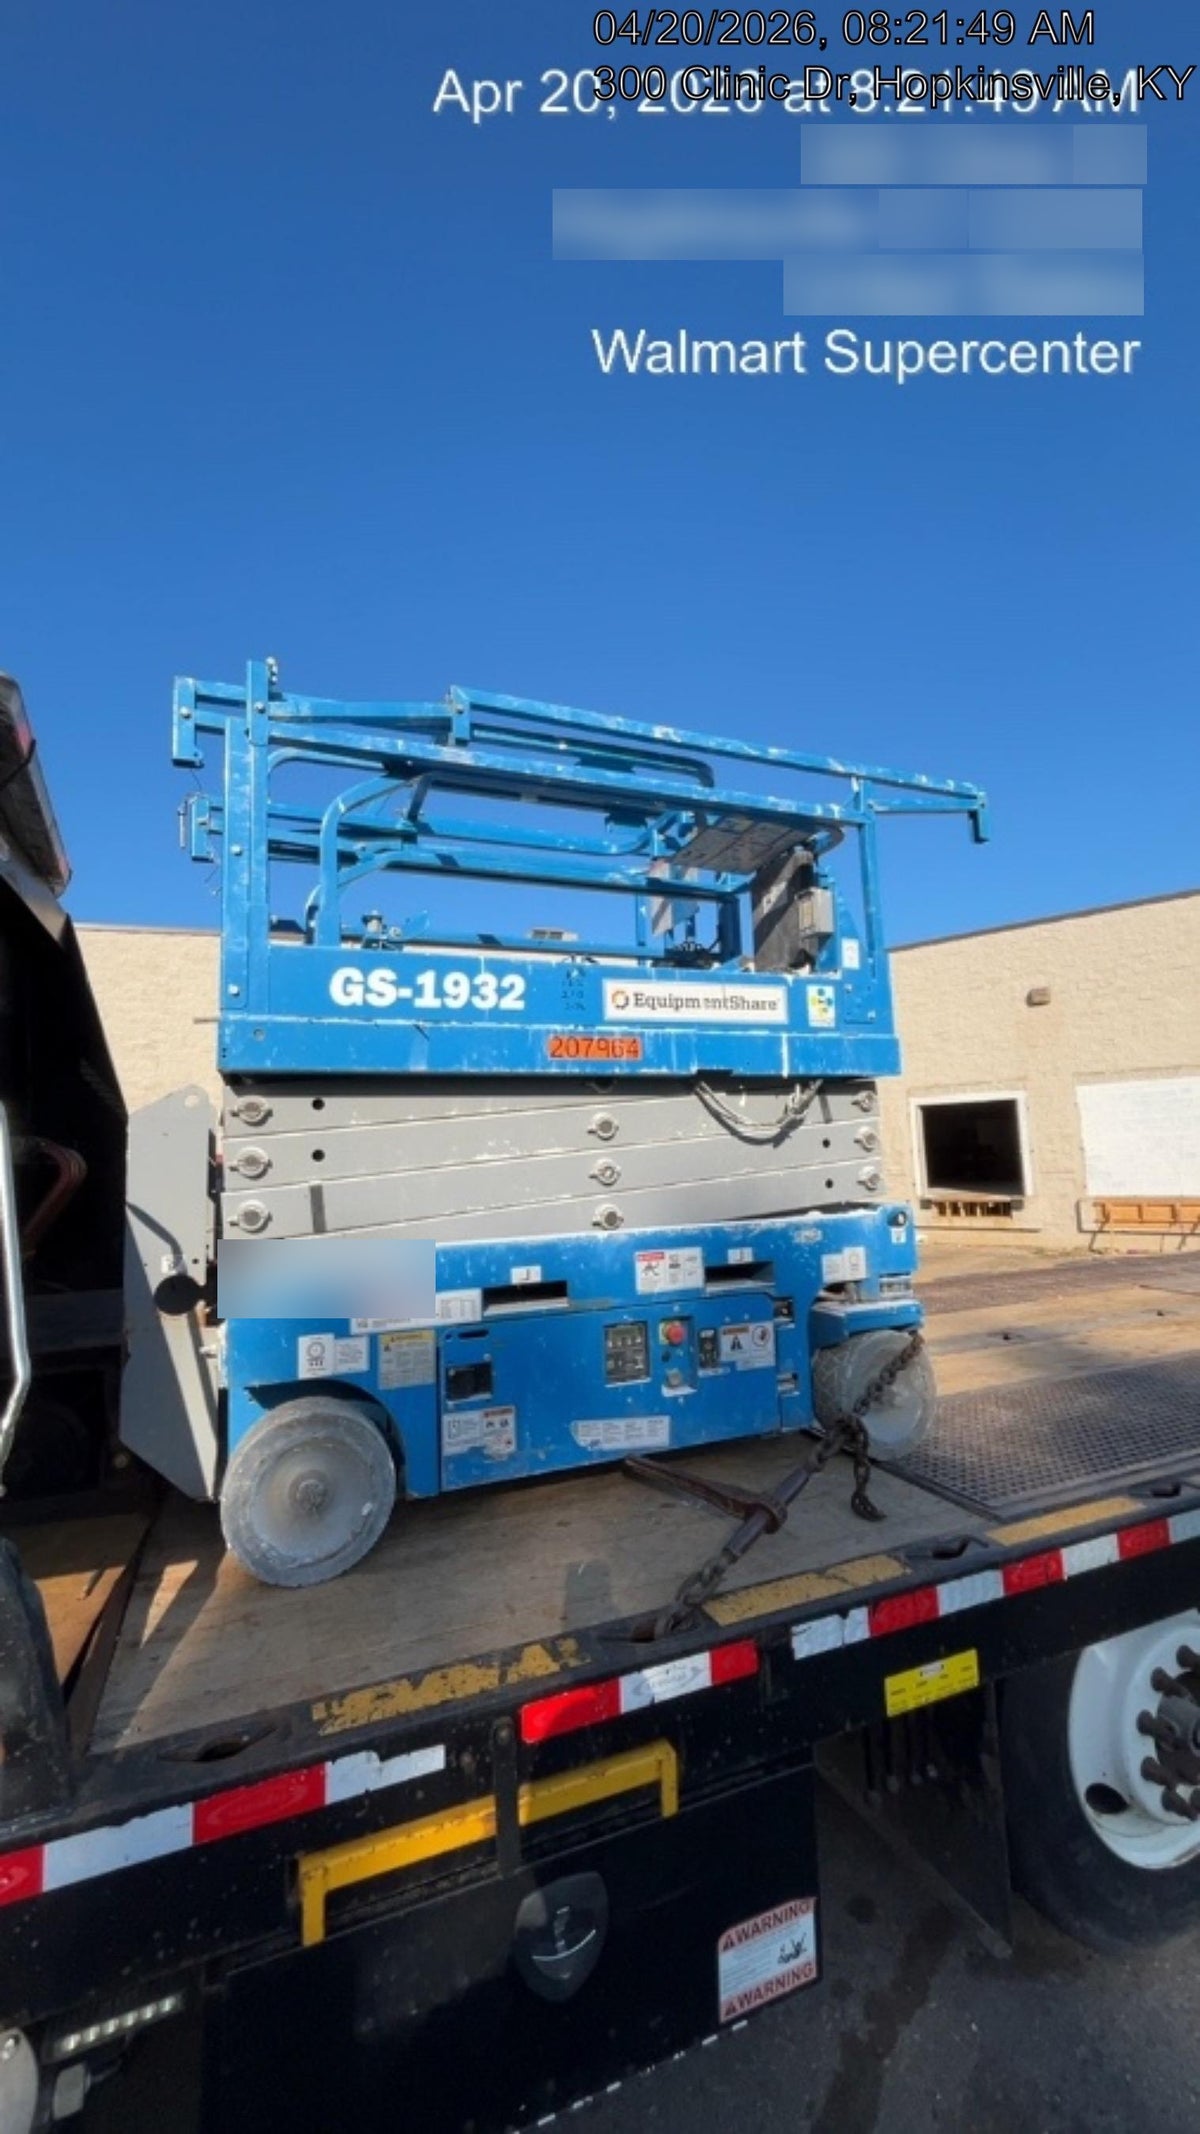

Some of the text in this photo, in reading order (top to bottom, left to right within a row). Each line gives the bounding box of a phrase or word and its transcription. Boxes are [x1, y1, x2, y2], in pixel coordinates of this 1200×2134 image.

[329, 966, 526, 1011] GS-1932
[633, 992, 779, 1011] EquipmentShare
[549, 1035, 639, 1059] 207964
[735, 1901, 811, 1943] WARNING
[737, 1962, 813, 2009] WARNING
